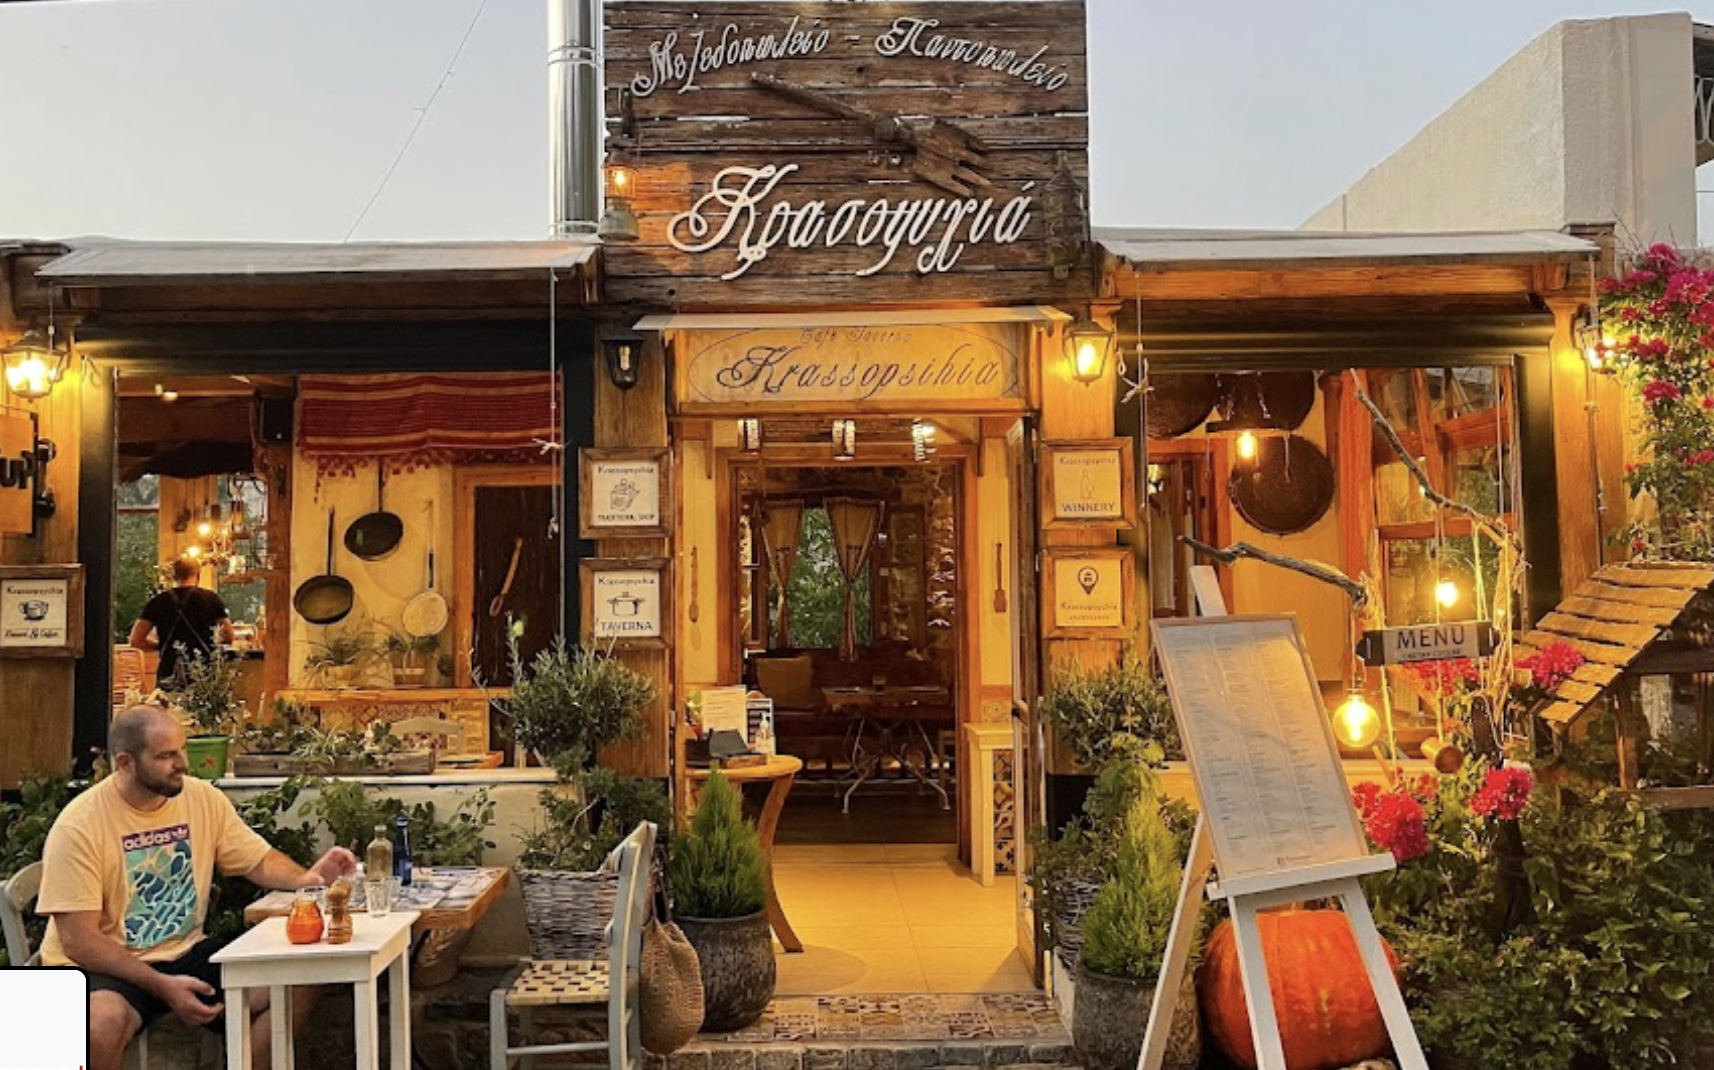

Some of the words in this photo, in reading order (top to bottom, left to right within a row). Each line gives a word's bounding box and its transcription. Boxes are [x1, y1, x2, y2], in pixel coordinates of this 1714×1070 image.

[716, 344, 999, 400] Krassopsihia
[1062, 502, 1115, 512] WINNERY
[600, 621, 653, 631] TAVERNA
[1397, 626, 1465, 649] MENU
[124, 831, 171, 850] adidas
